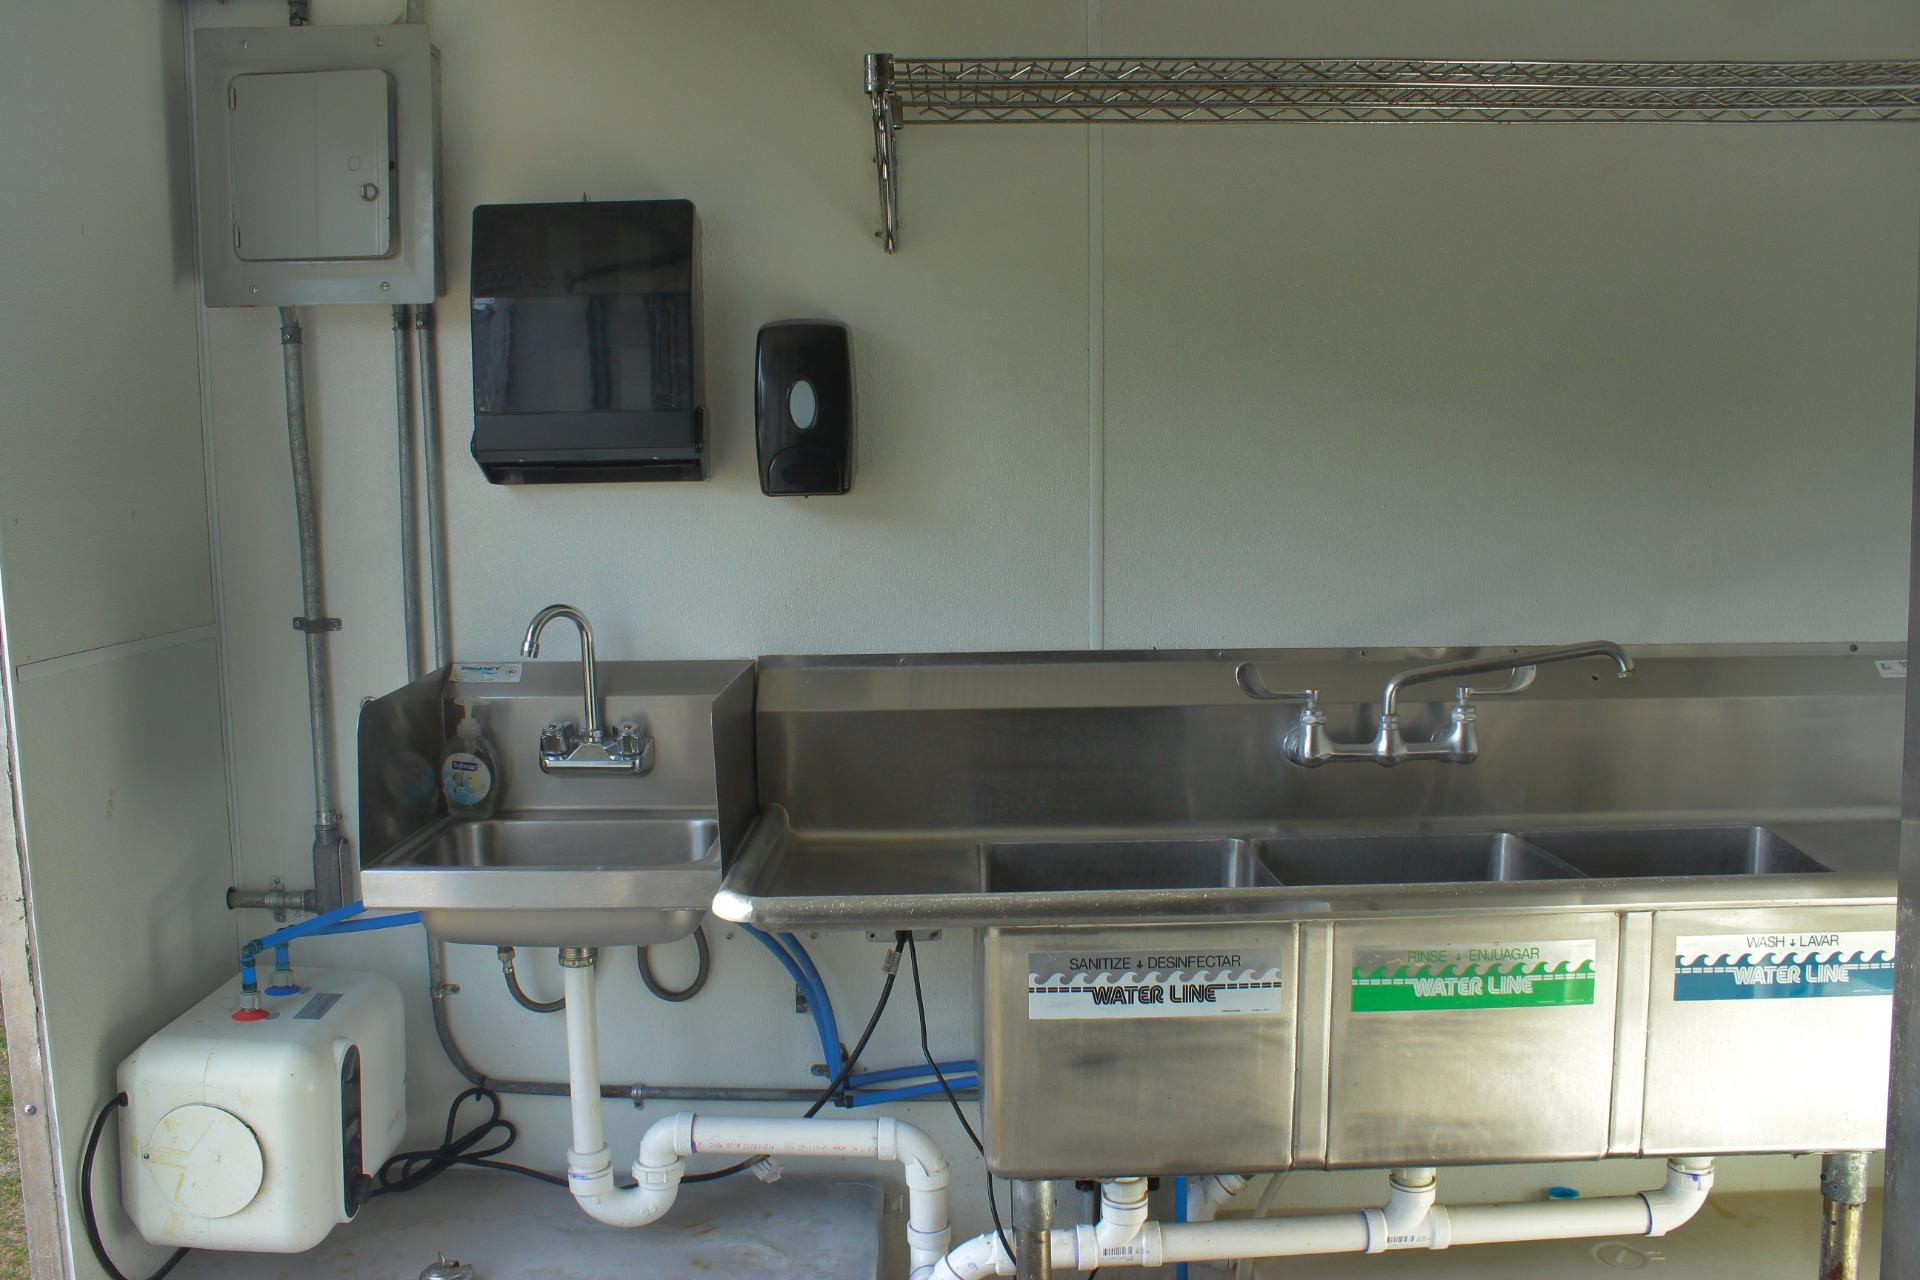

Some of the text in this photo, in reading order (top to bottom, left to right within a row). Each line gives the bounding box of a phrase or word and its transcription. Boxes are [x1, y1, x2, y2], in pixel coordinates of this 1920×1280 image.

[1747, 934, 1839, 949] WASH LAVAR
[1069, 955, 1241, 970] SANITIZE DESINFECTAR
[1408, 947, 1540, 963] RINSE ENJUAGAR
[1734, 964, 1850, 985] WATER LINE
[1092, 983, 1217, 1005] WATER LINE
[1414, 975, 1533, 997] WATER LINE
